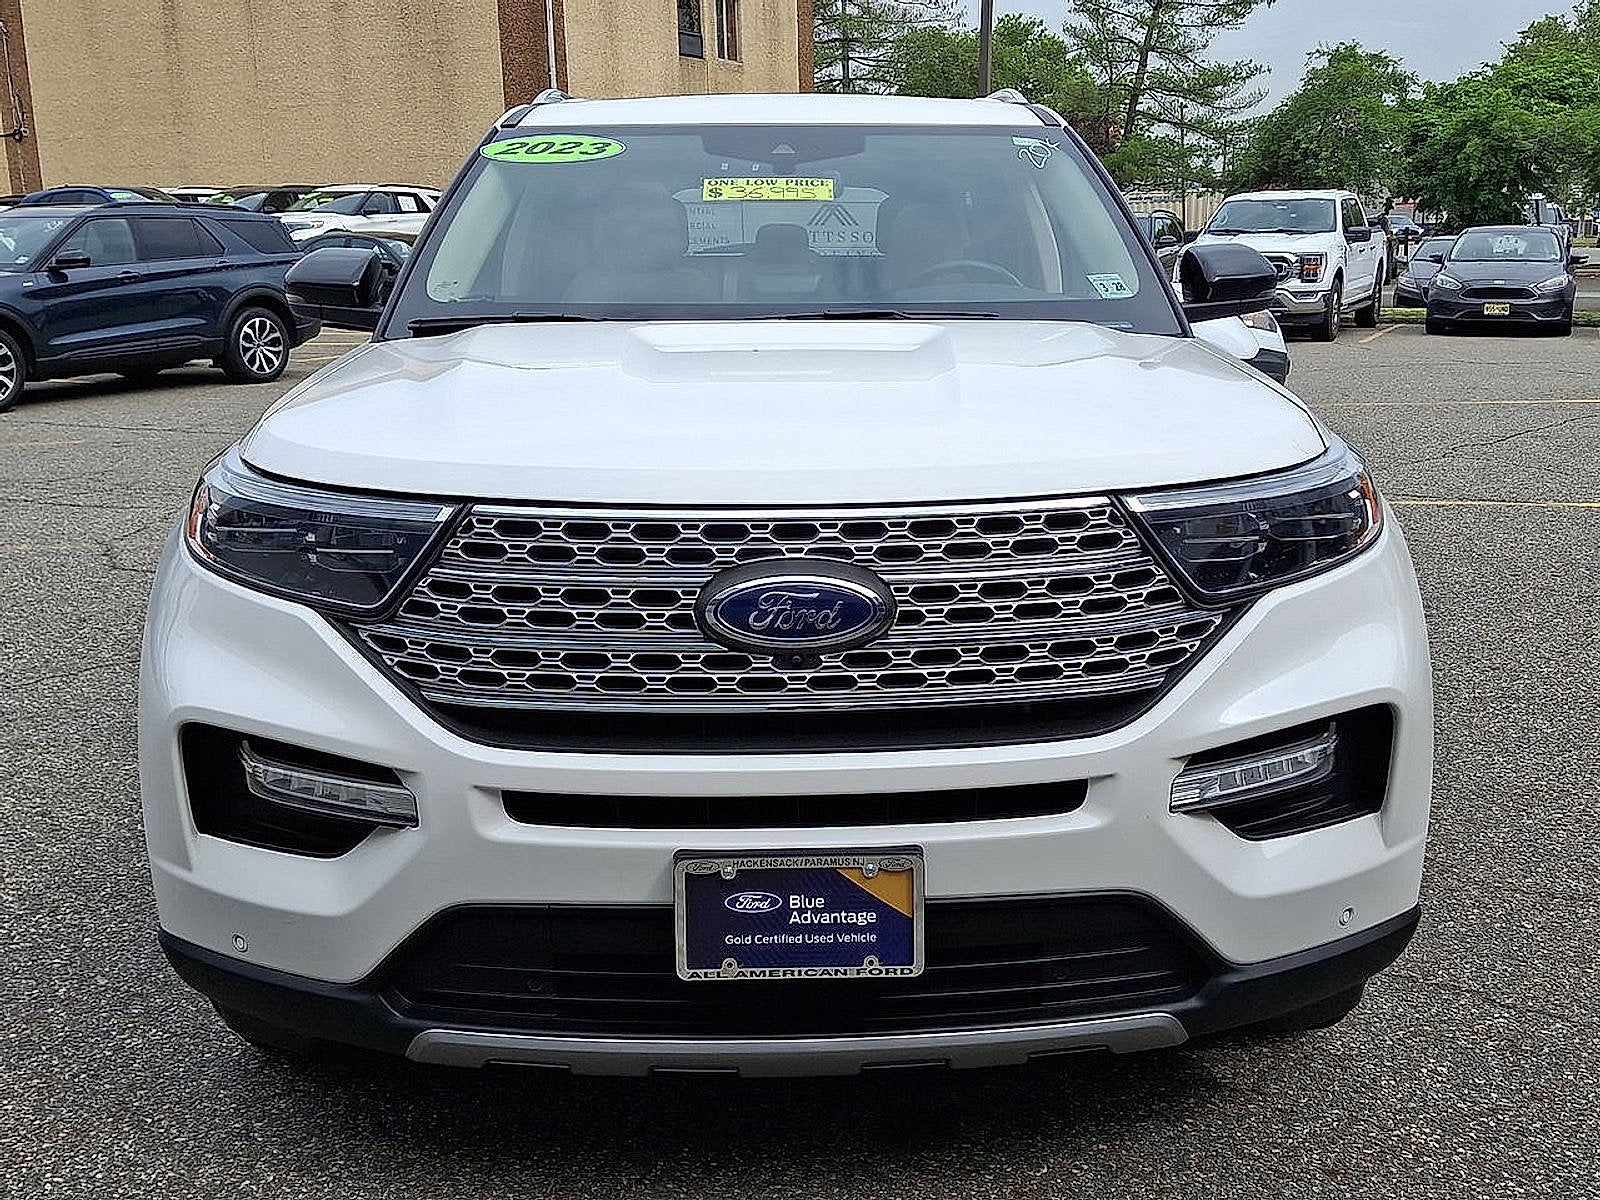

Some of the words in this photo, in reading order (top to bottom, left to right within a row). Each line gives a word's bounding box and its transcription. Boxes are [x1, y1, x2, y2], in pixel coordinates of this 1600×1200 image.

[494, 141, 611, 155] 2023
[707, 179, 738, 187] ONE
[745, 178, 778, 186] LOW
[785, 179, 829, 187] PRICE
[708, 187, 723, 198] $
[748, 591, 843, 630] Ford
[735, 894, 771, 909] Ford
[789, 895, 825, 909] Blue
[788, 910, 877, 925] Advantage
[724, 934, 752, 945] Gold
[754, 934, 801, 944] Certified
[805, 933, 834, 943] Used
[837, 932, 877, 943] Vehicle
[687, 971, 728, 980] ALL
[735, 968, 848, 979] AMERICAN
[856, 967, 914, 976] FORD
